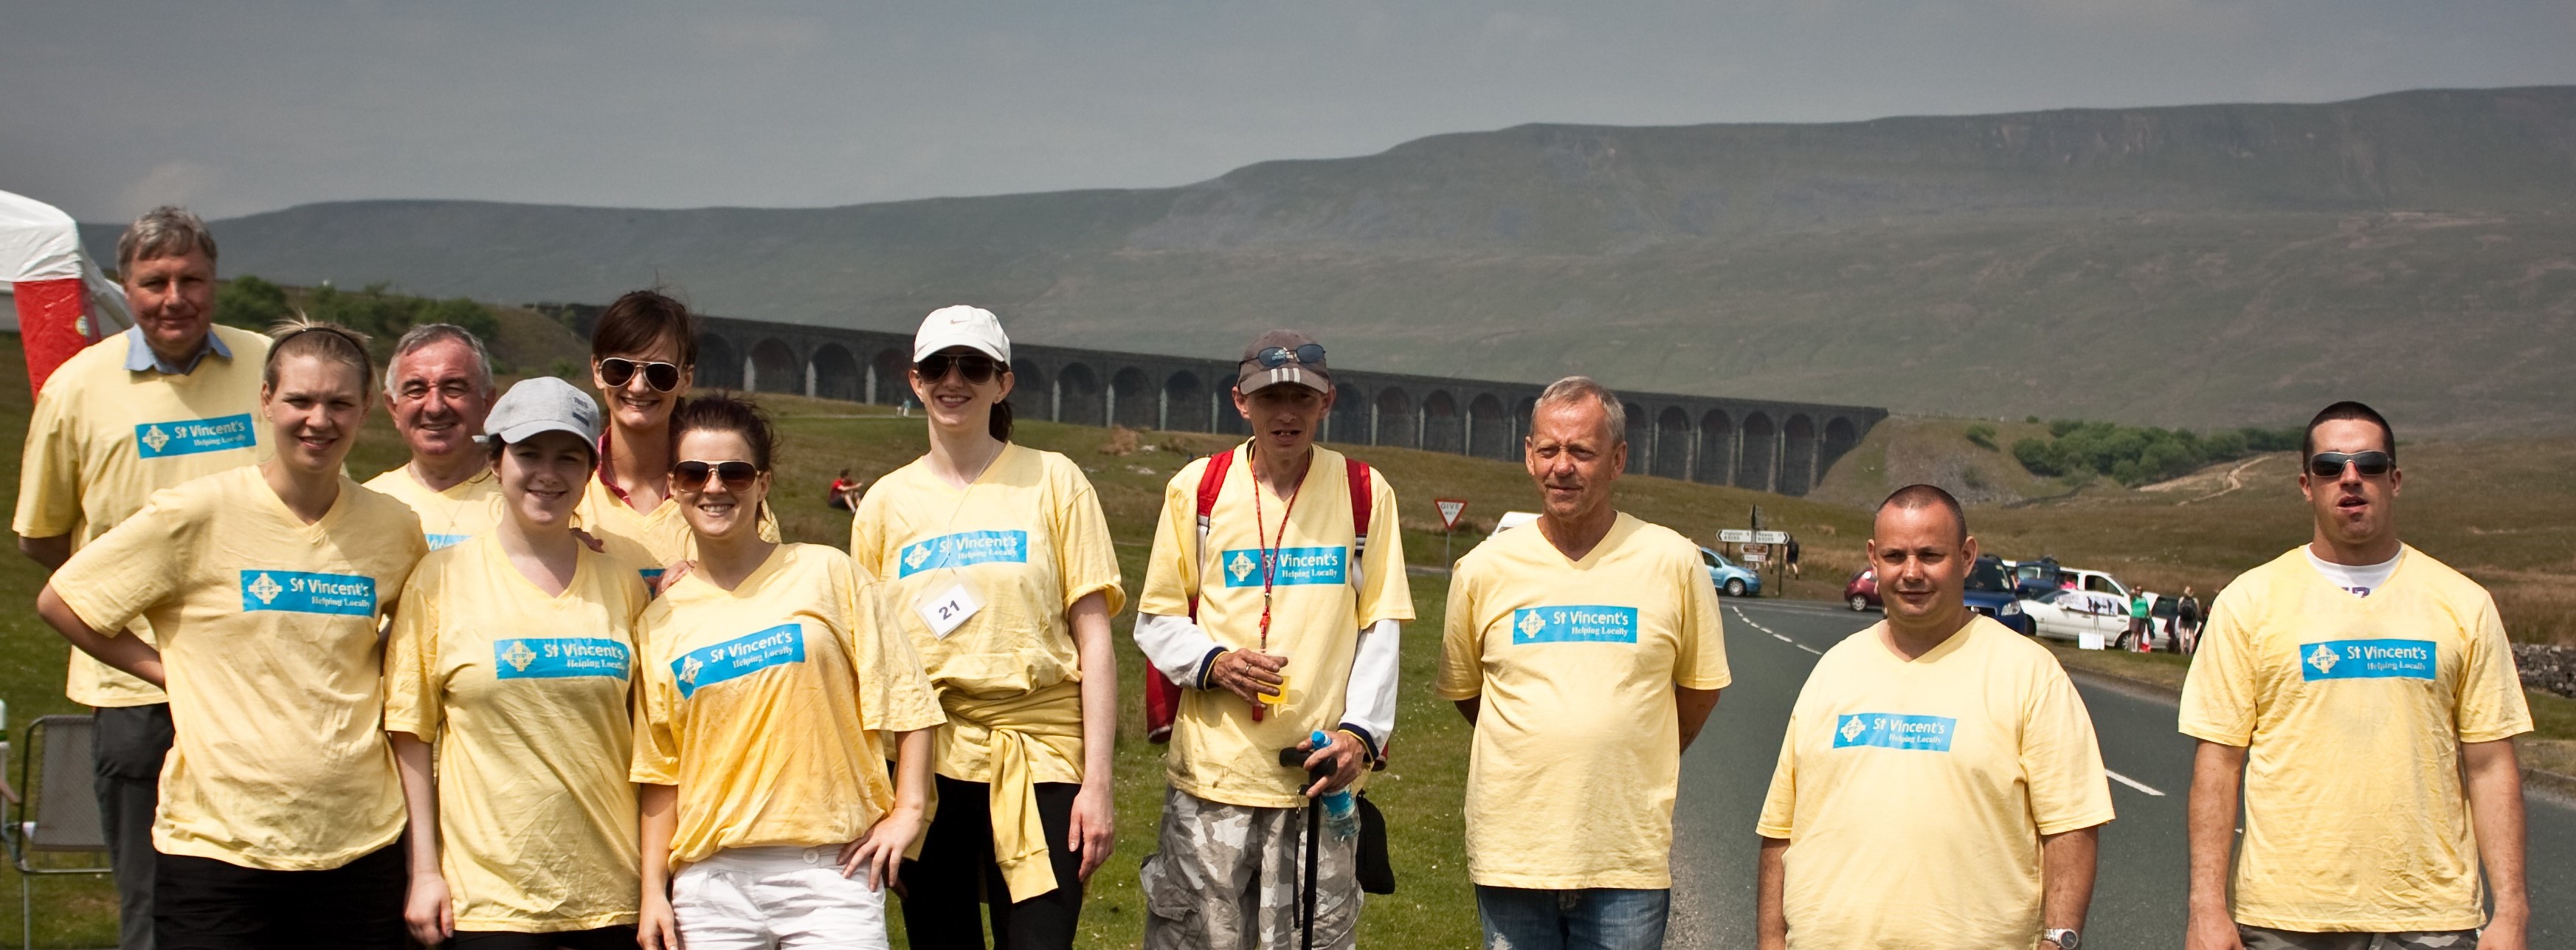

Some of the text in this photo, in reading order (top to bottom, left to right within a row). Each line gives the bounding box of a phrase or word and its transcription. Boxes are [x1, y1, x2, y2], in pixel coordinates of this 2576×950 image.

[175, 420, 245, 439] St Vincent's
[193, 438, 221, 447] Helping
[956, 536, 1018, 551] Vincent's
[958, 548, 1018, 560] Helping Locally
[1280, 553, 1338, 568] Vincent's
[1282, 568, 1338, 579] Helping Locally
[290, 577, 370, 597] St Vincent's
[311, 596, 370, 609] Helping Locally
[939, 600, 960, 620] 21
[1553, 610, 1629, 626] St Vincent's
[1571, 626, 1628, 637] Helping Locally
[543, 643, 625, 660] St Vincent's
[711, 631, 793, 664] St Vincent's
[2347, 646, 2427, 661] St Vincent's
[567, 658, 601, 670] Helping
[732, 646, 793, 669] Helping Locally
[2366, 661, 2426, 672] Helping Locally
[1872, 717, 1946, 734] St Vincent's
[1888, 733, 1943, 746] Helping Locally
